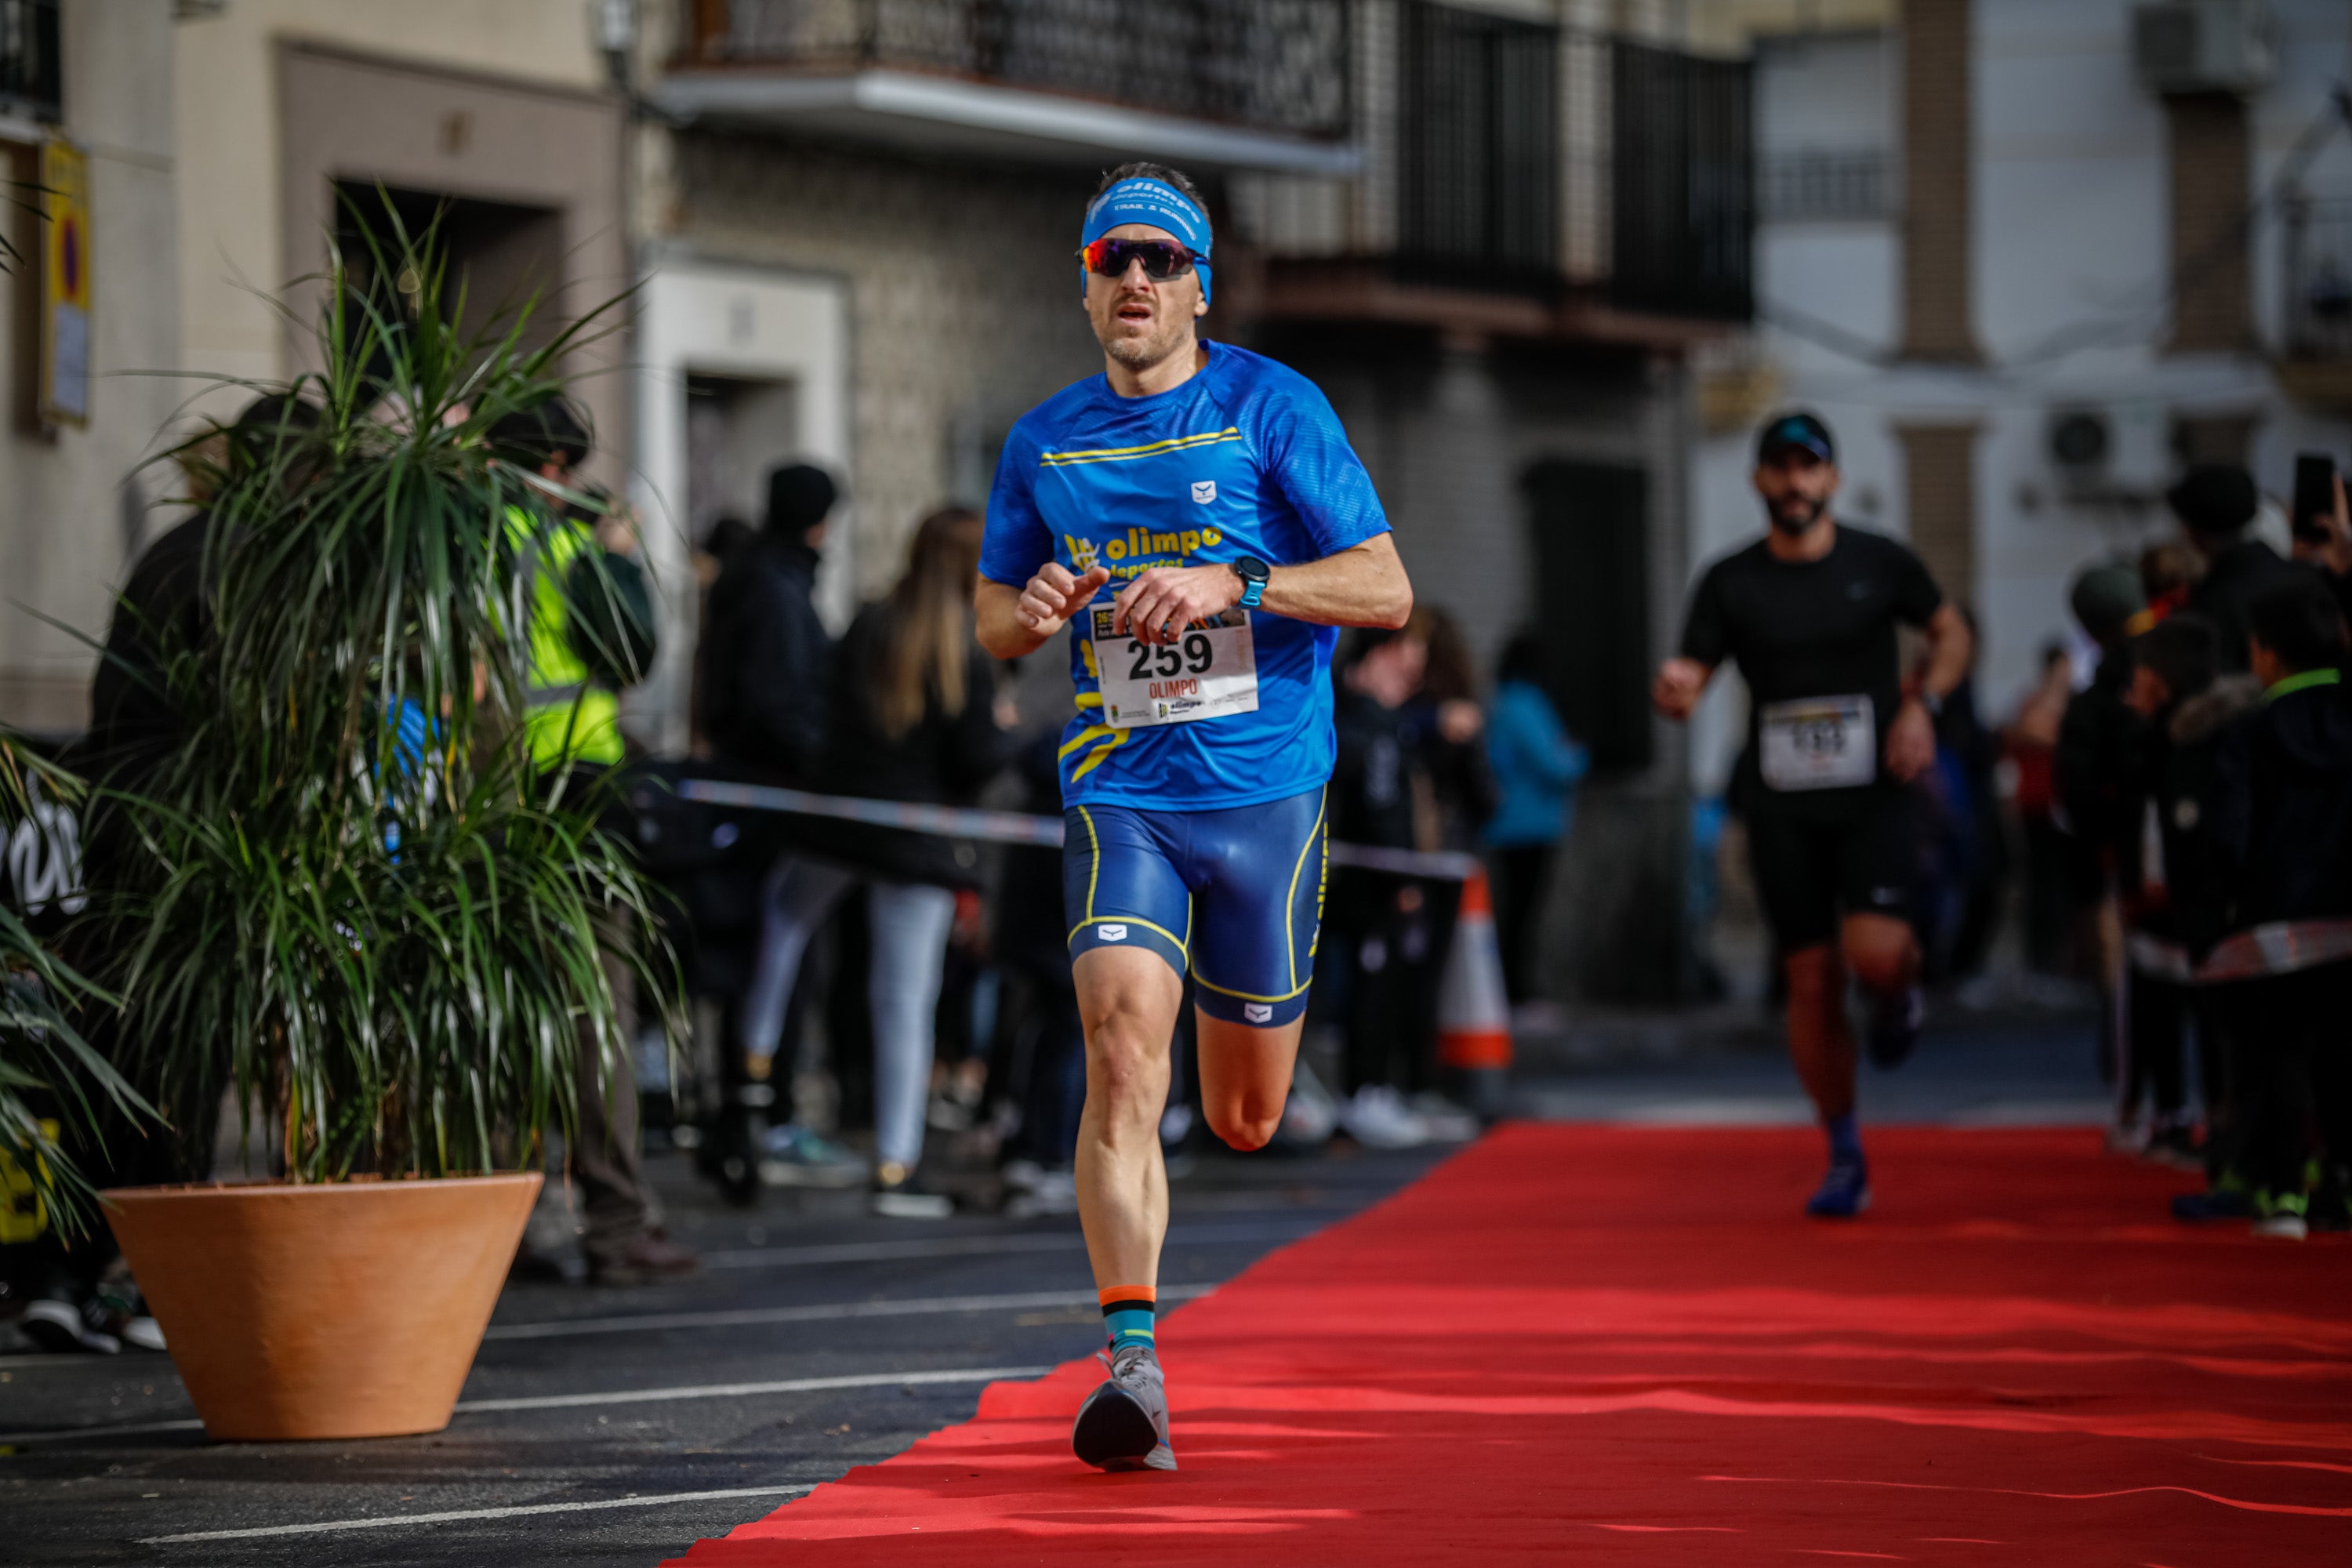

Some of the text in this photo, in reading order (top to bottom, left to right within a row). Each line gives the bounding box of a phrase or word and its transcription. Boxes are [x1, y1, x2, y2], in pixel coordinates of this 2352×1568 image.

[1113, 203, 1145, 212] TRAIL
[1116, 182, 1200, 223] olimpo
[1105, 527, 1223, 561] olimpo
[1127, 633, 1213, 681] 259
[1149, 677, 1199, 699] OLIMPO
